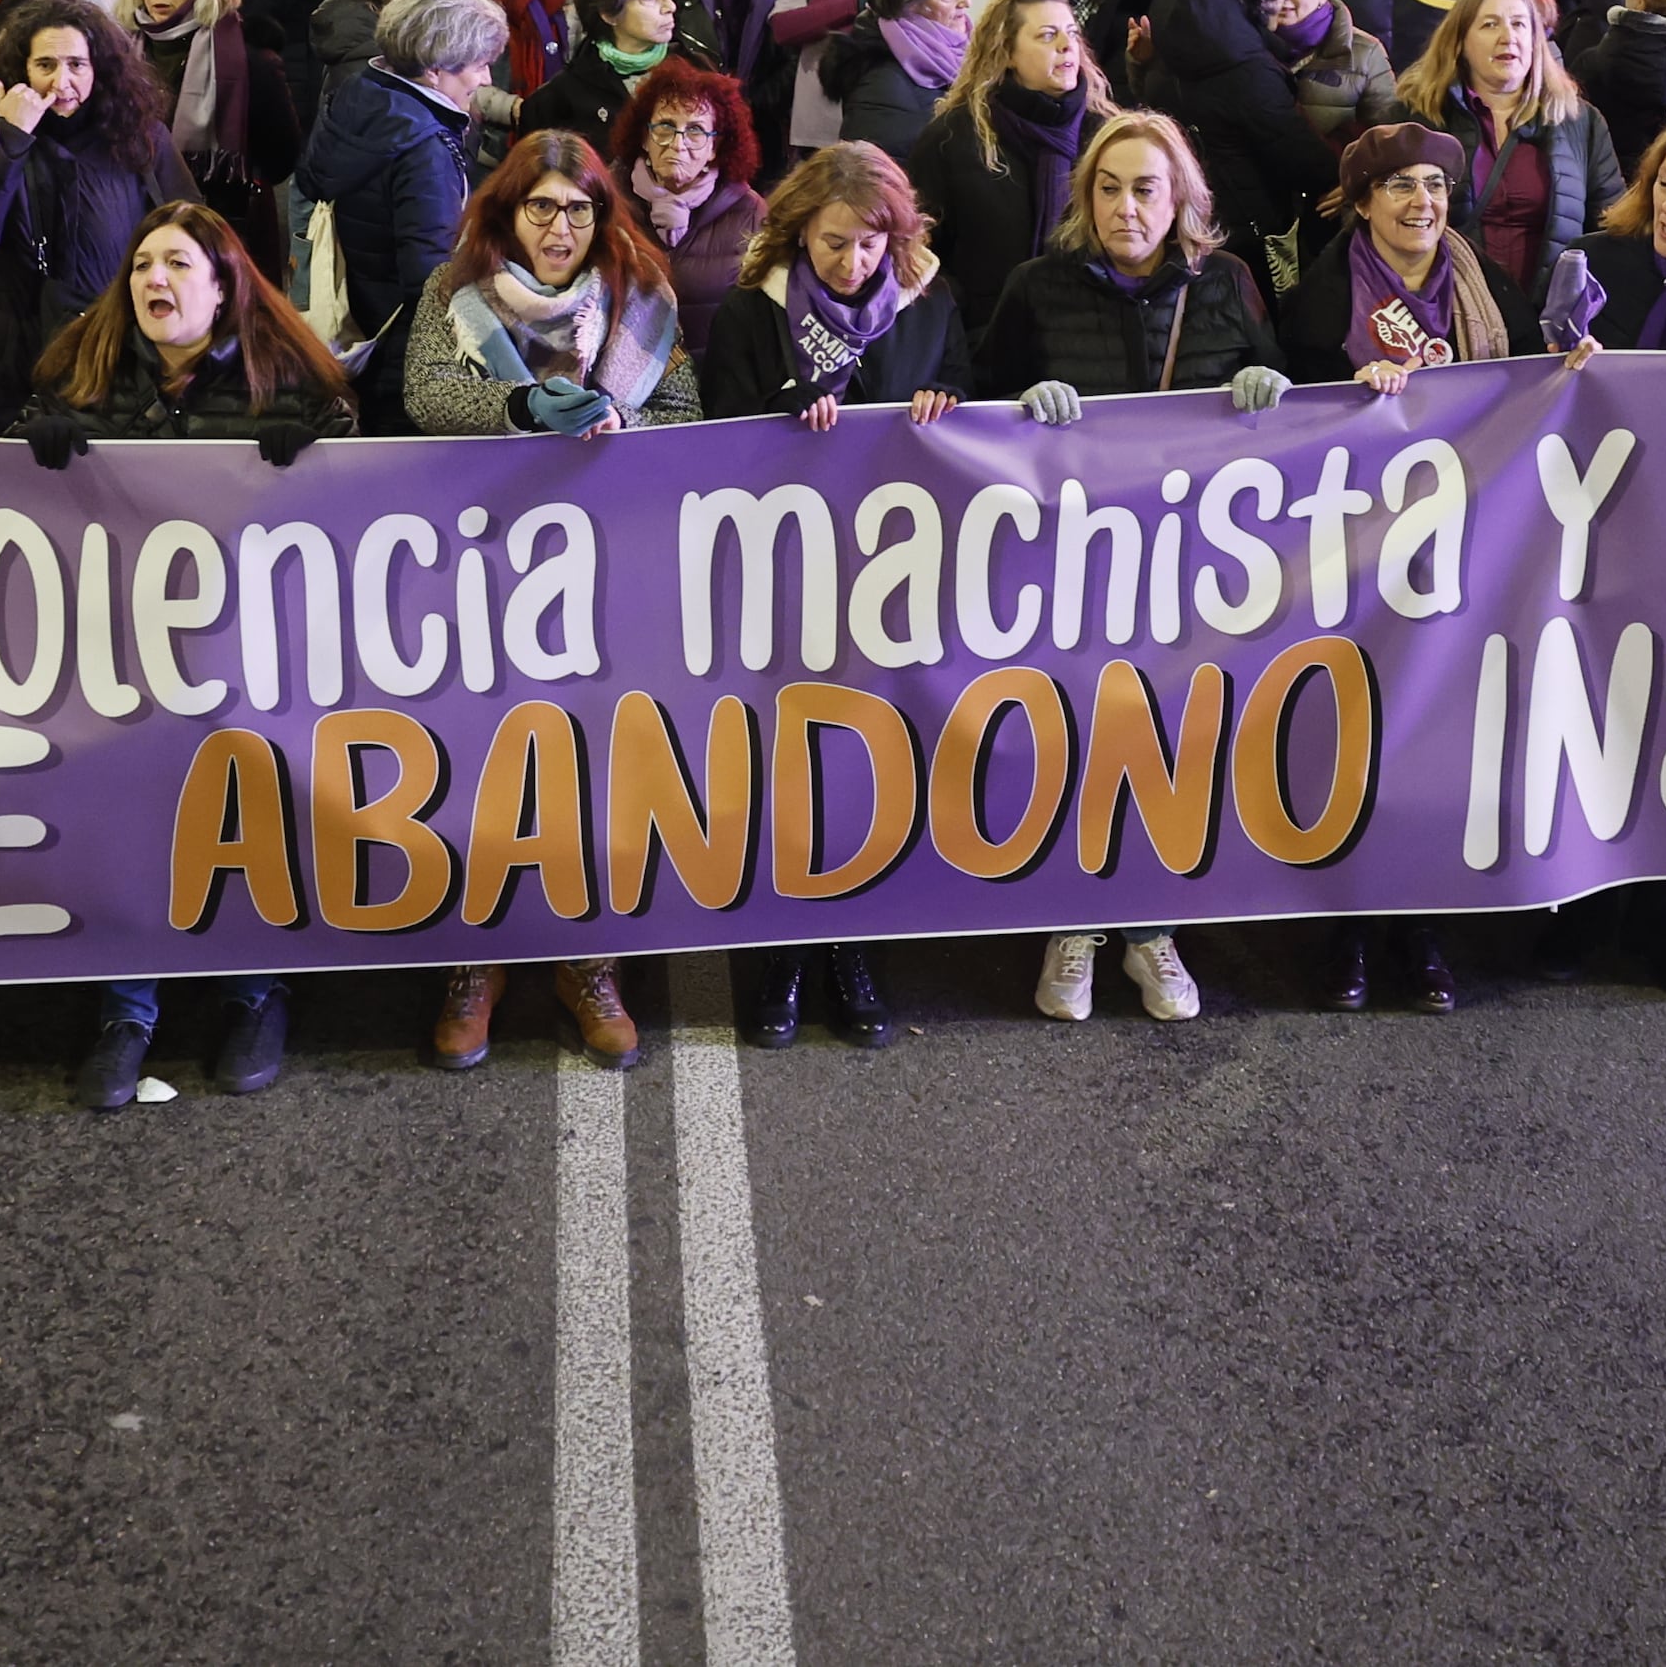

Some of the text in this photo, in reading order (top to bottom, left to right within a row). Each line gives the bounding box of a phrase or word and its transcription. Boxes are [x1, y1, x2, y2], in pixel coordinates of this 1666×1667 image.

[798, 335, 839, 374] ALCO
[680, 437, 1466, 677] machista
[169, 634, 1378, 934] ABANDONO
